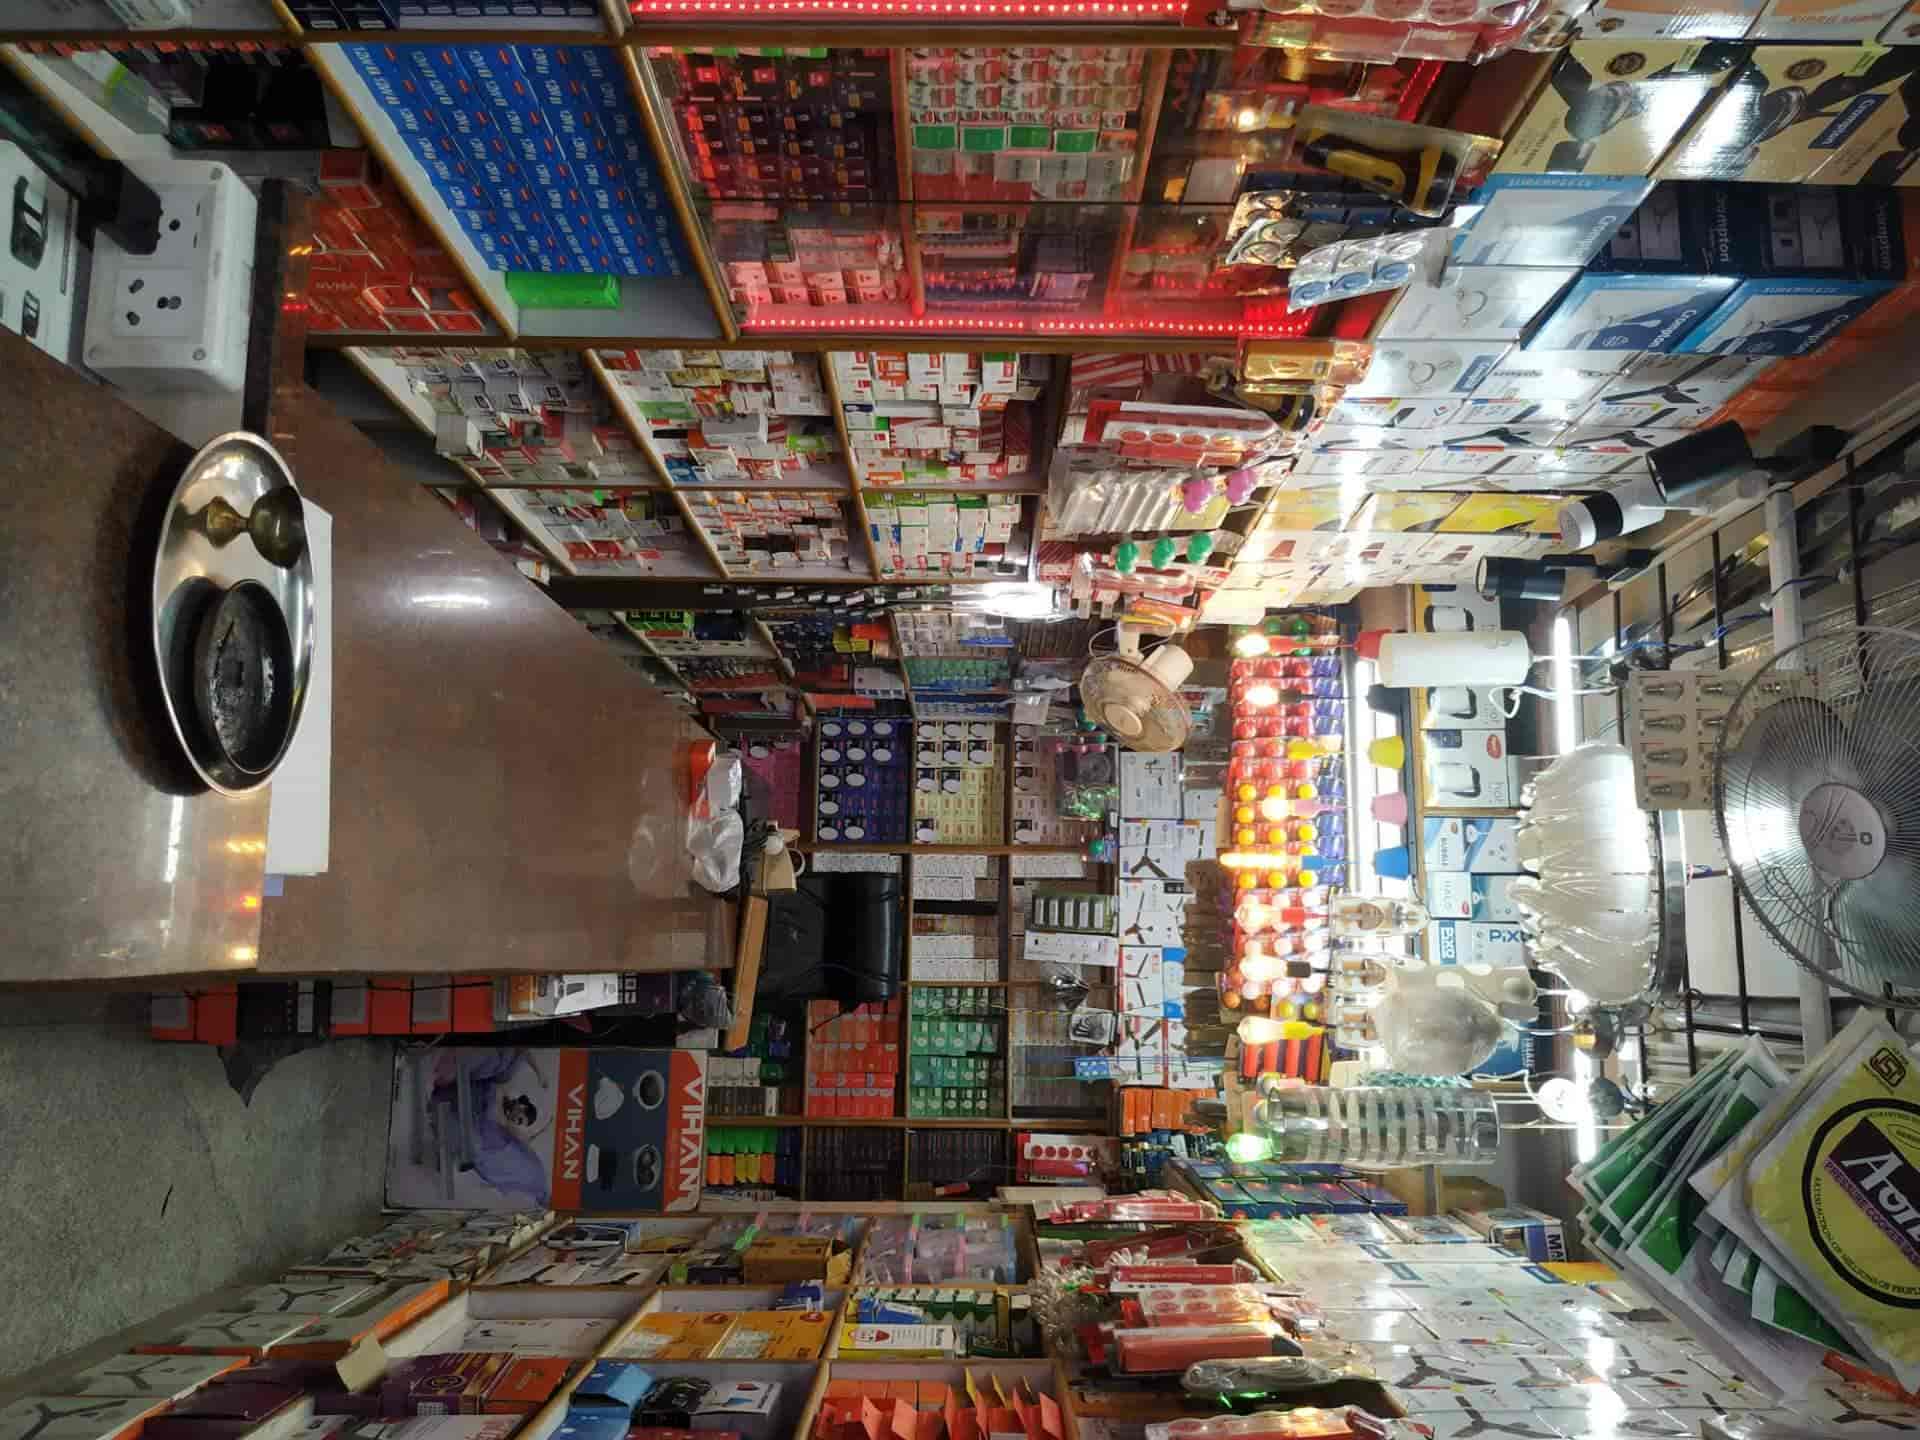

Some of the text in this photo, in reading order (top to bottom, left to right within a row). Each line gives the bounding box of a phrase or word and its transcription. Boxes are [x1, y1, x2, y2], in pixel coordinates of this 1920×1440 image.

[1647, 310, 1697, 348] Crompton
[562, 1083, 584, 1181] VIHAN
[679, 1074, 703, 1193] VIHAN
[1547, 1234, 1565, 1263] MA
